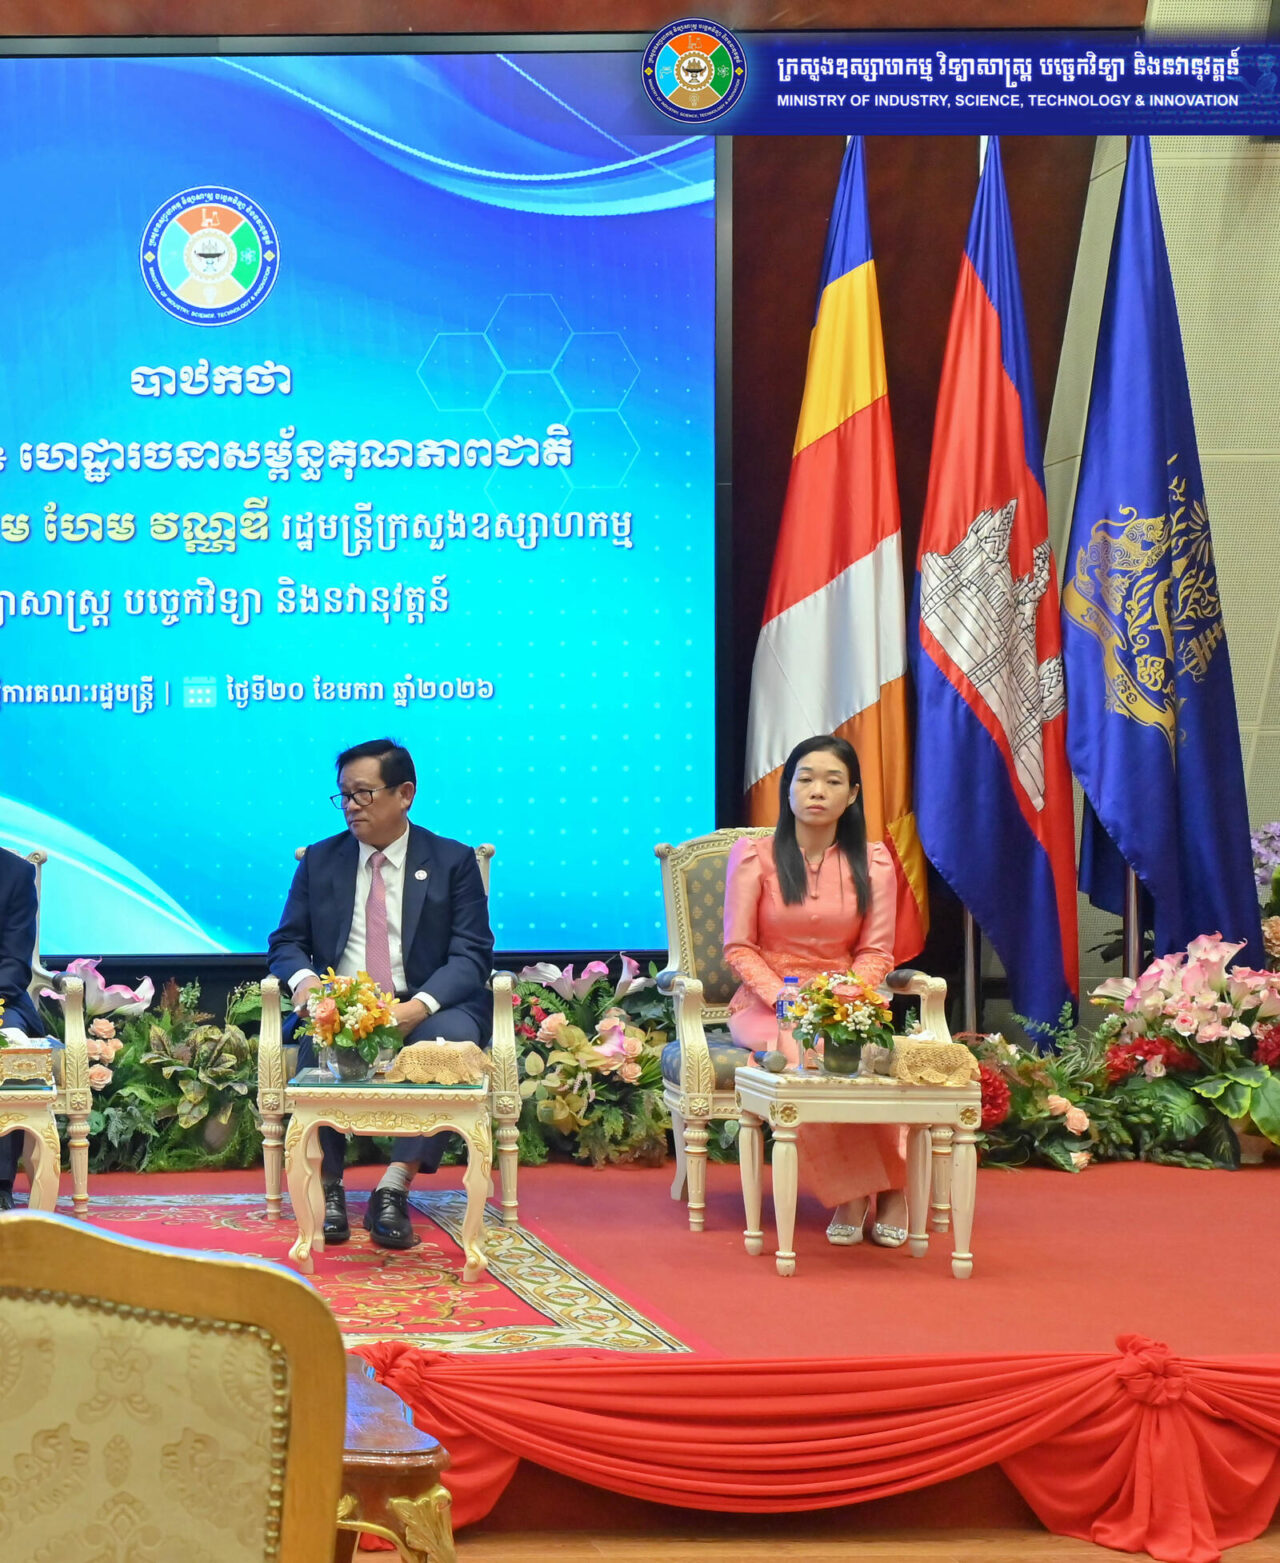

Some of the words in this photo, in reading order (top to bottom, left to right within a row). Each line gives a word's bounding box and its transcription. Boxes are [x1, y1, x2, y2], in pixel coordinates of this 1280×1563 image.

[130, 358, 291, 397] បាឋកថា
[44, 501, 135, 542] ហែម
[124, 576, 261, 626] បច្ចេកវិទ្យា
[226, 674, 304, 708] ថ្ងៃទី២០
[312, 674, 384, 700] ខែមករា
